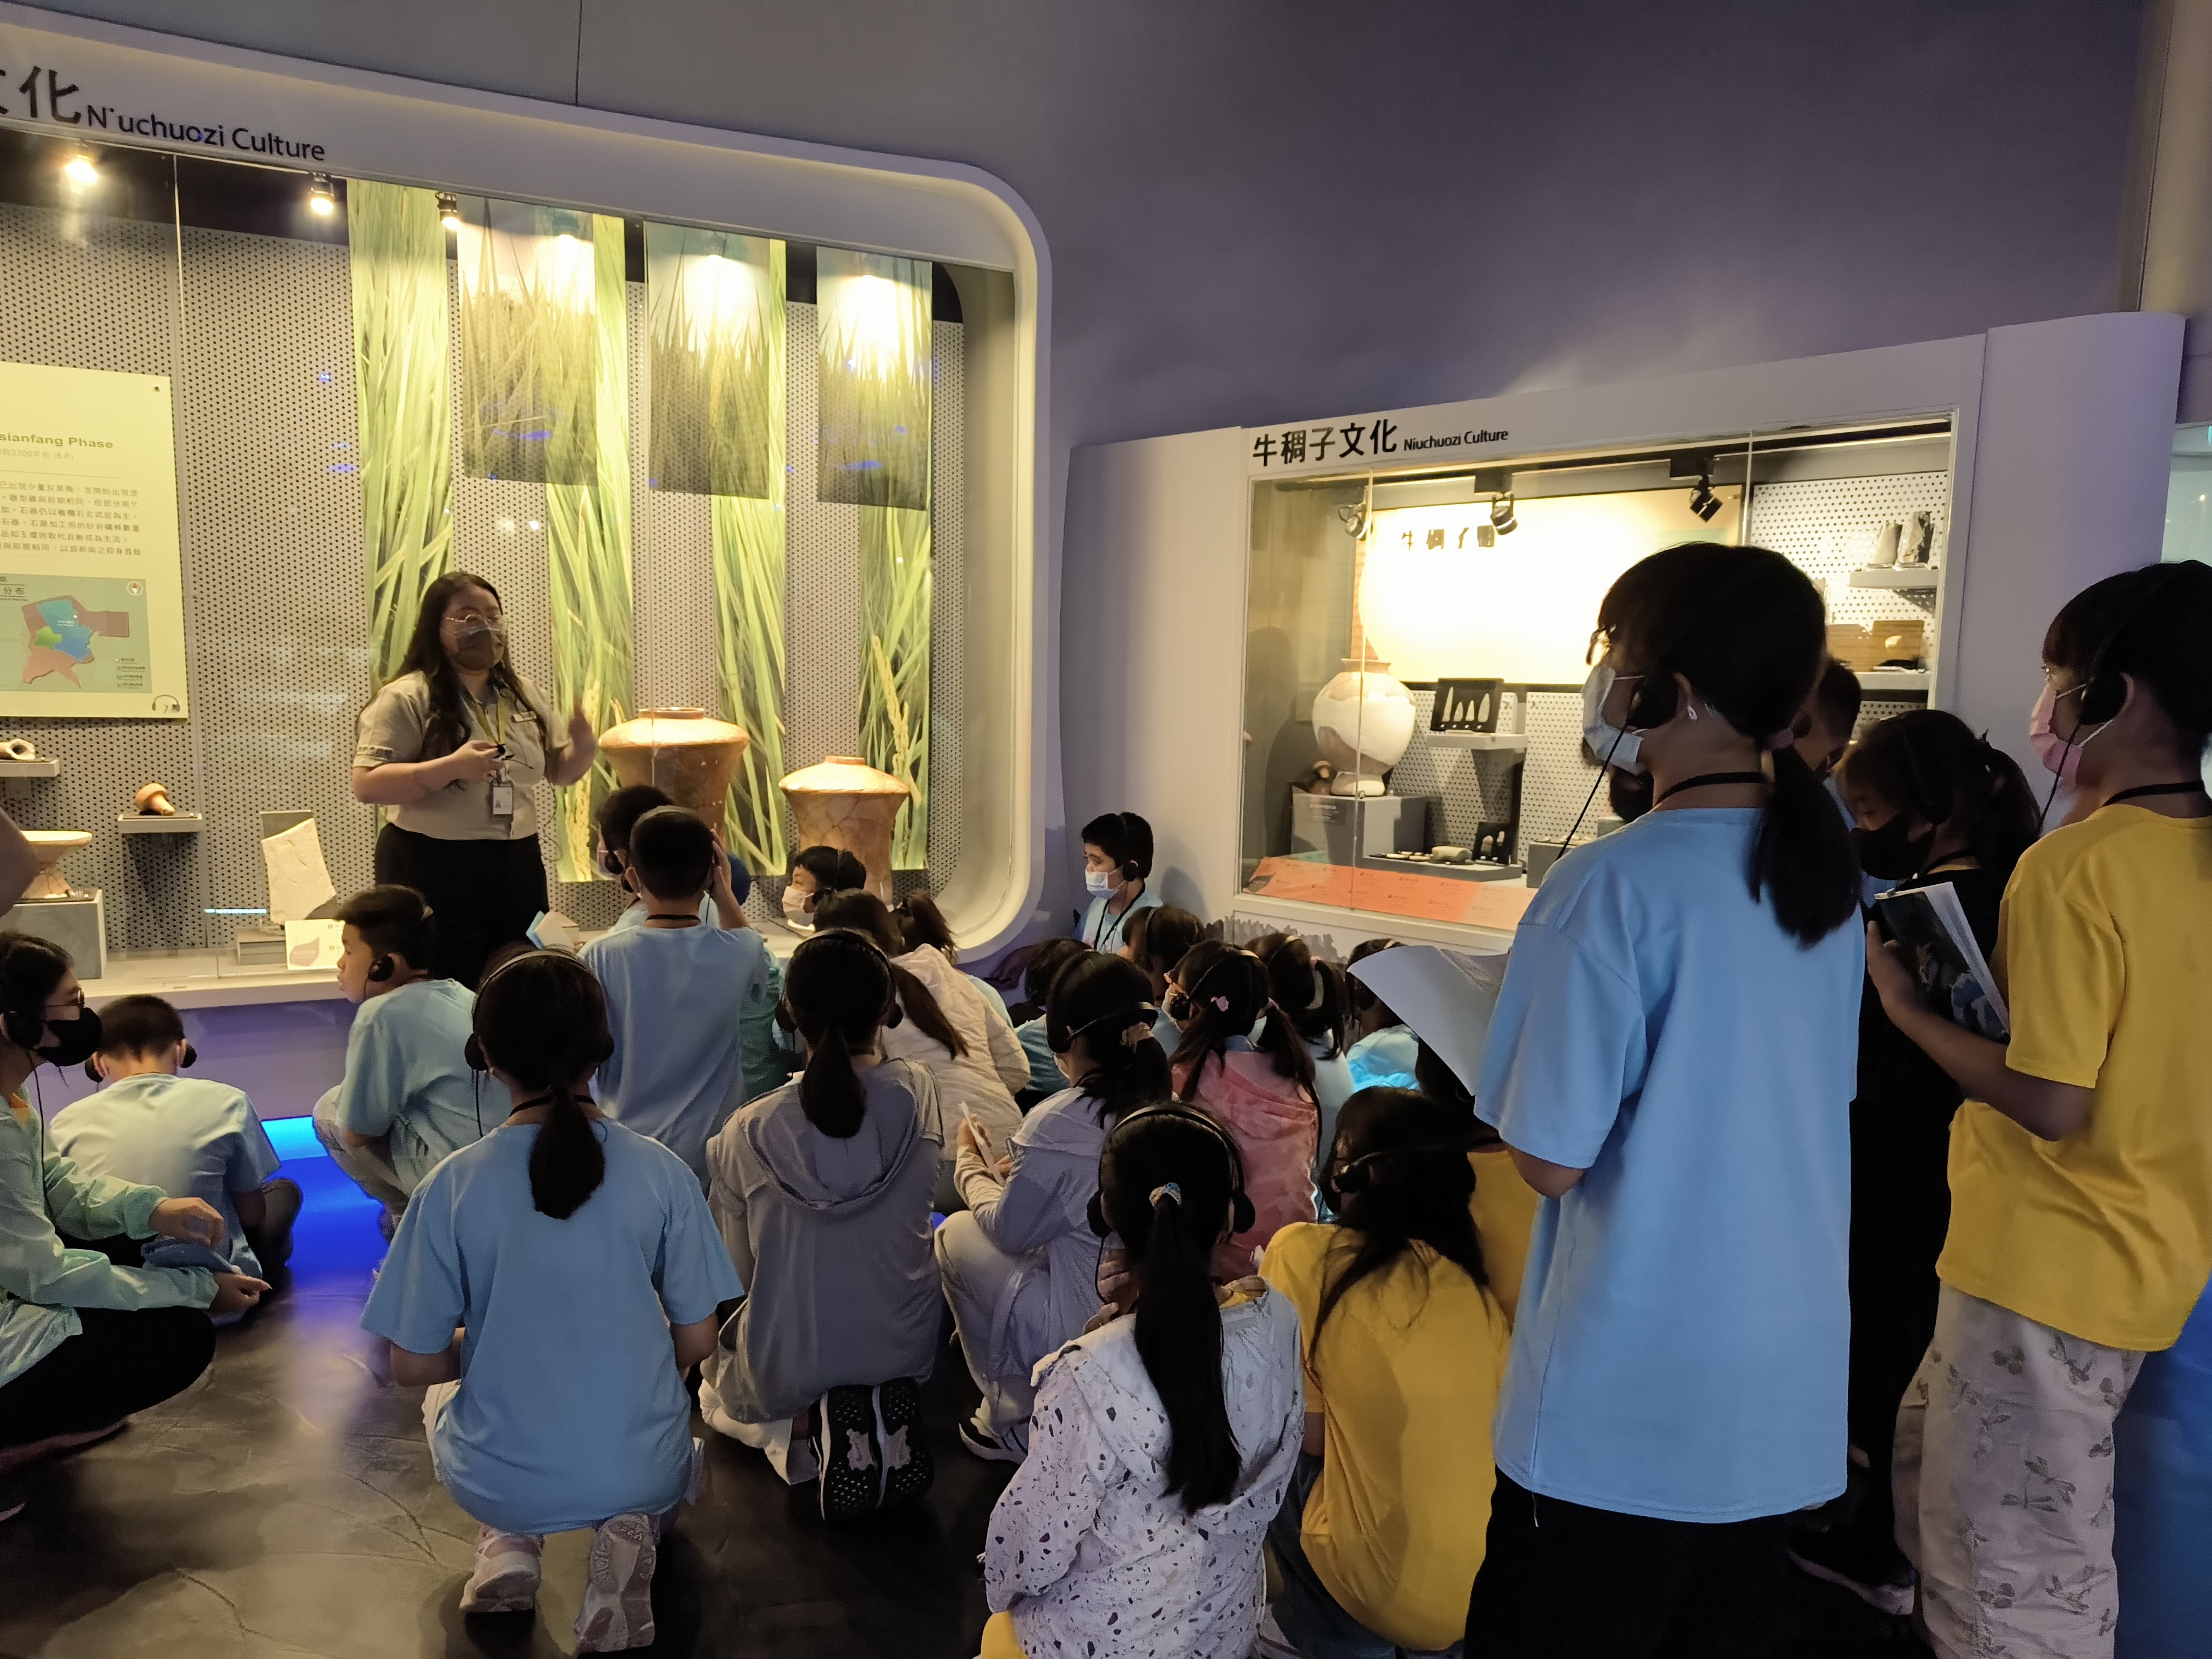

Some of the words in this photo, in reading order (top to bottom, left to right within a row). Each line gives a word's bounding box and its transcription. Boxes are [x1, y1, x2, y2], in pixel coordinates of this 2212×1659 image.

[0, 65, 82, 124] 化
[88, 104, 225, 147] Nuchuozi
[232, 128, 325, 161] Culture
[69, 437, 113, 448] Phase
[1253, 419, 1397, 467] 牛稠子文化
[1403, 433, 1462, 451] Niuchuozi
[1464, 430, 1508, 445] Culture
